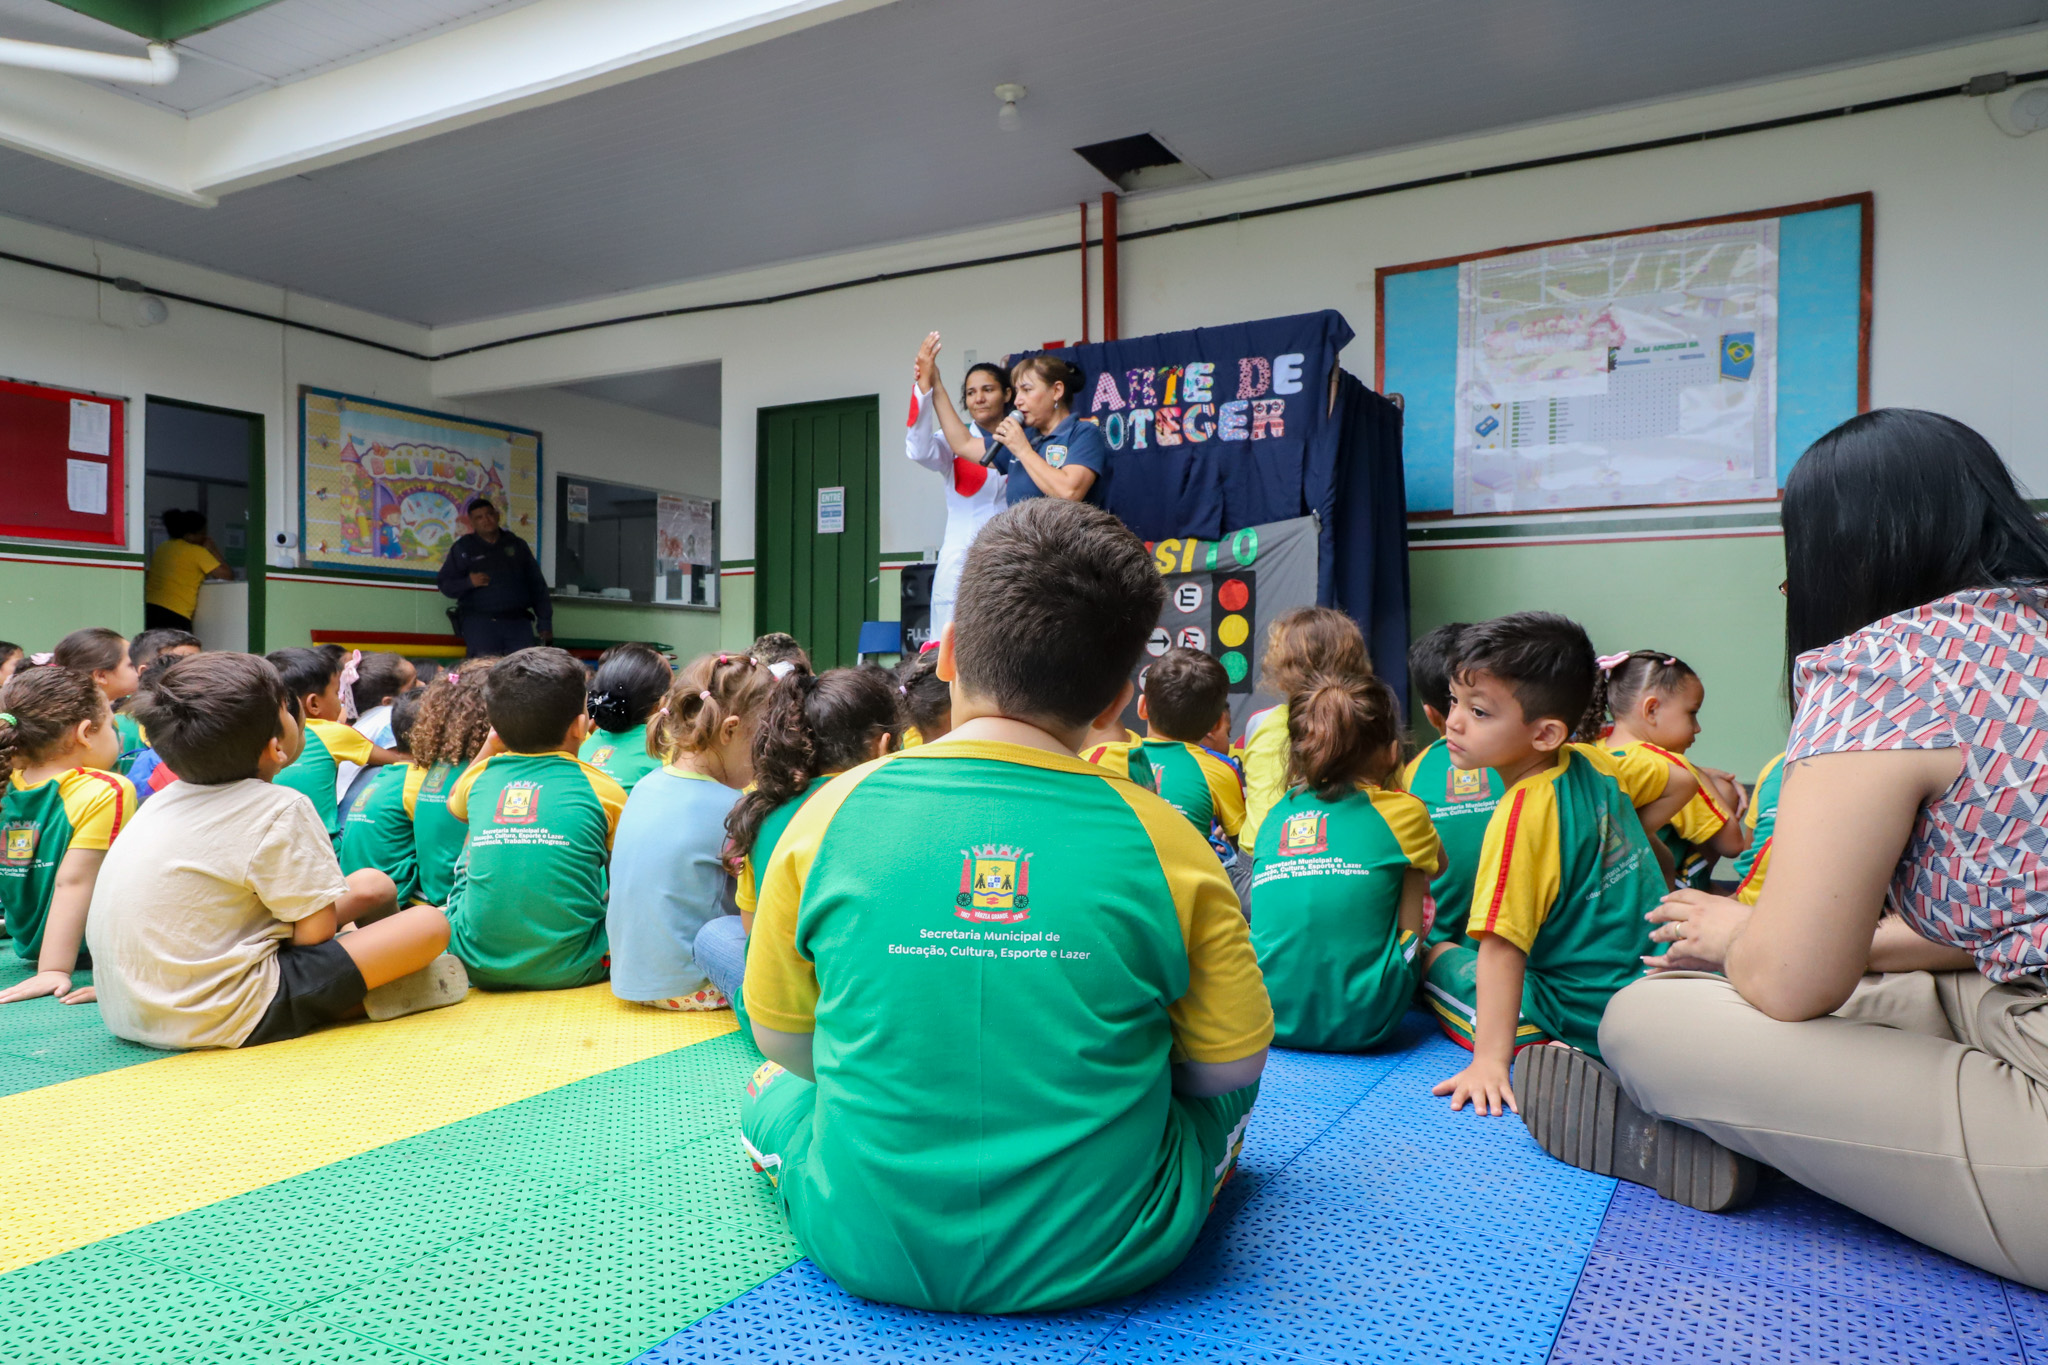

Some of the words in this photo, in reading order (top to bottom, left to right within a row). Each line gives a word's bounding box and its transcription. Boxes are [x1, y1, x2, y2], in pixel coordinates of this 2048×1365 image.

[1091, 361, 1215, 412] ARTE
[1236, 353, 1305, 399] DE
[1079, 398, 1286, 450] OTEGER
[370, 457, 412, 476] BEM
[1144, 527, 1258, 574] SITO
[1264, 858, 1296, 870] Secretaria
[1298, 856, 1332, 864] Municipal
[1280, 864, 1306, 873] Cultura,
[1292, 869, 1324, 878] Trabalho
[1332, 868, 1370, 876] Progresso
[920, 928, 981, 940] Secretaria
[984, 930, 1042, 944] Municipal
[1045, 932, 1060, 942] de
[888, 944, 948, 958] Educação,
[950, 946, 998, 959] Cultura,
[1000, 948, 1048, 960] Esporte
[1060, 949, 1091, 960] Lazer
